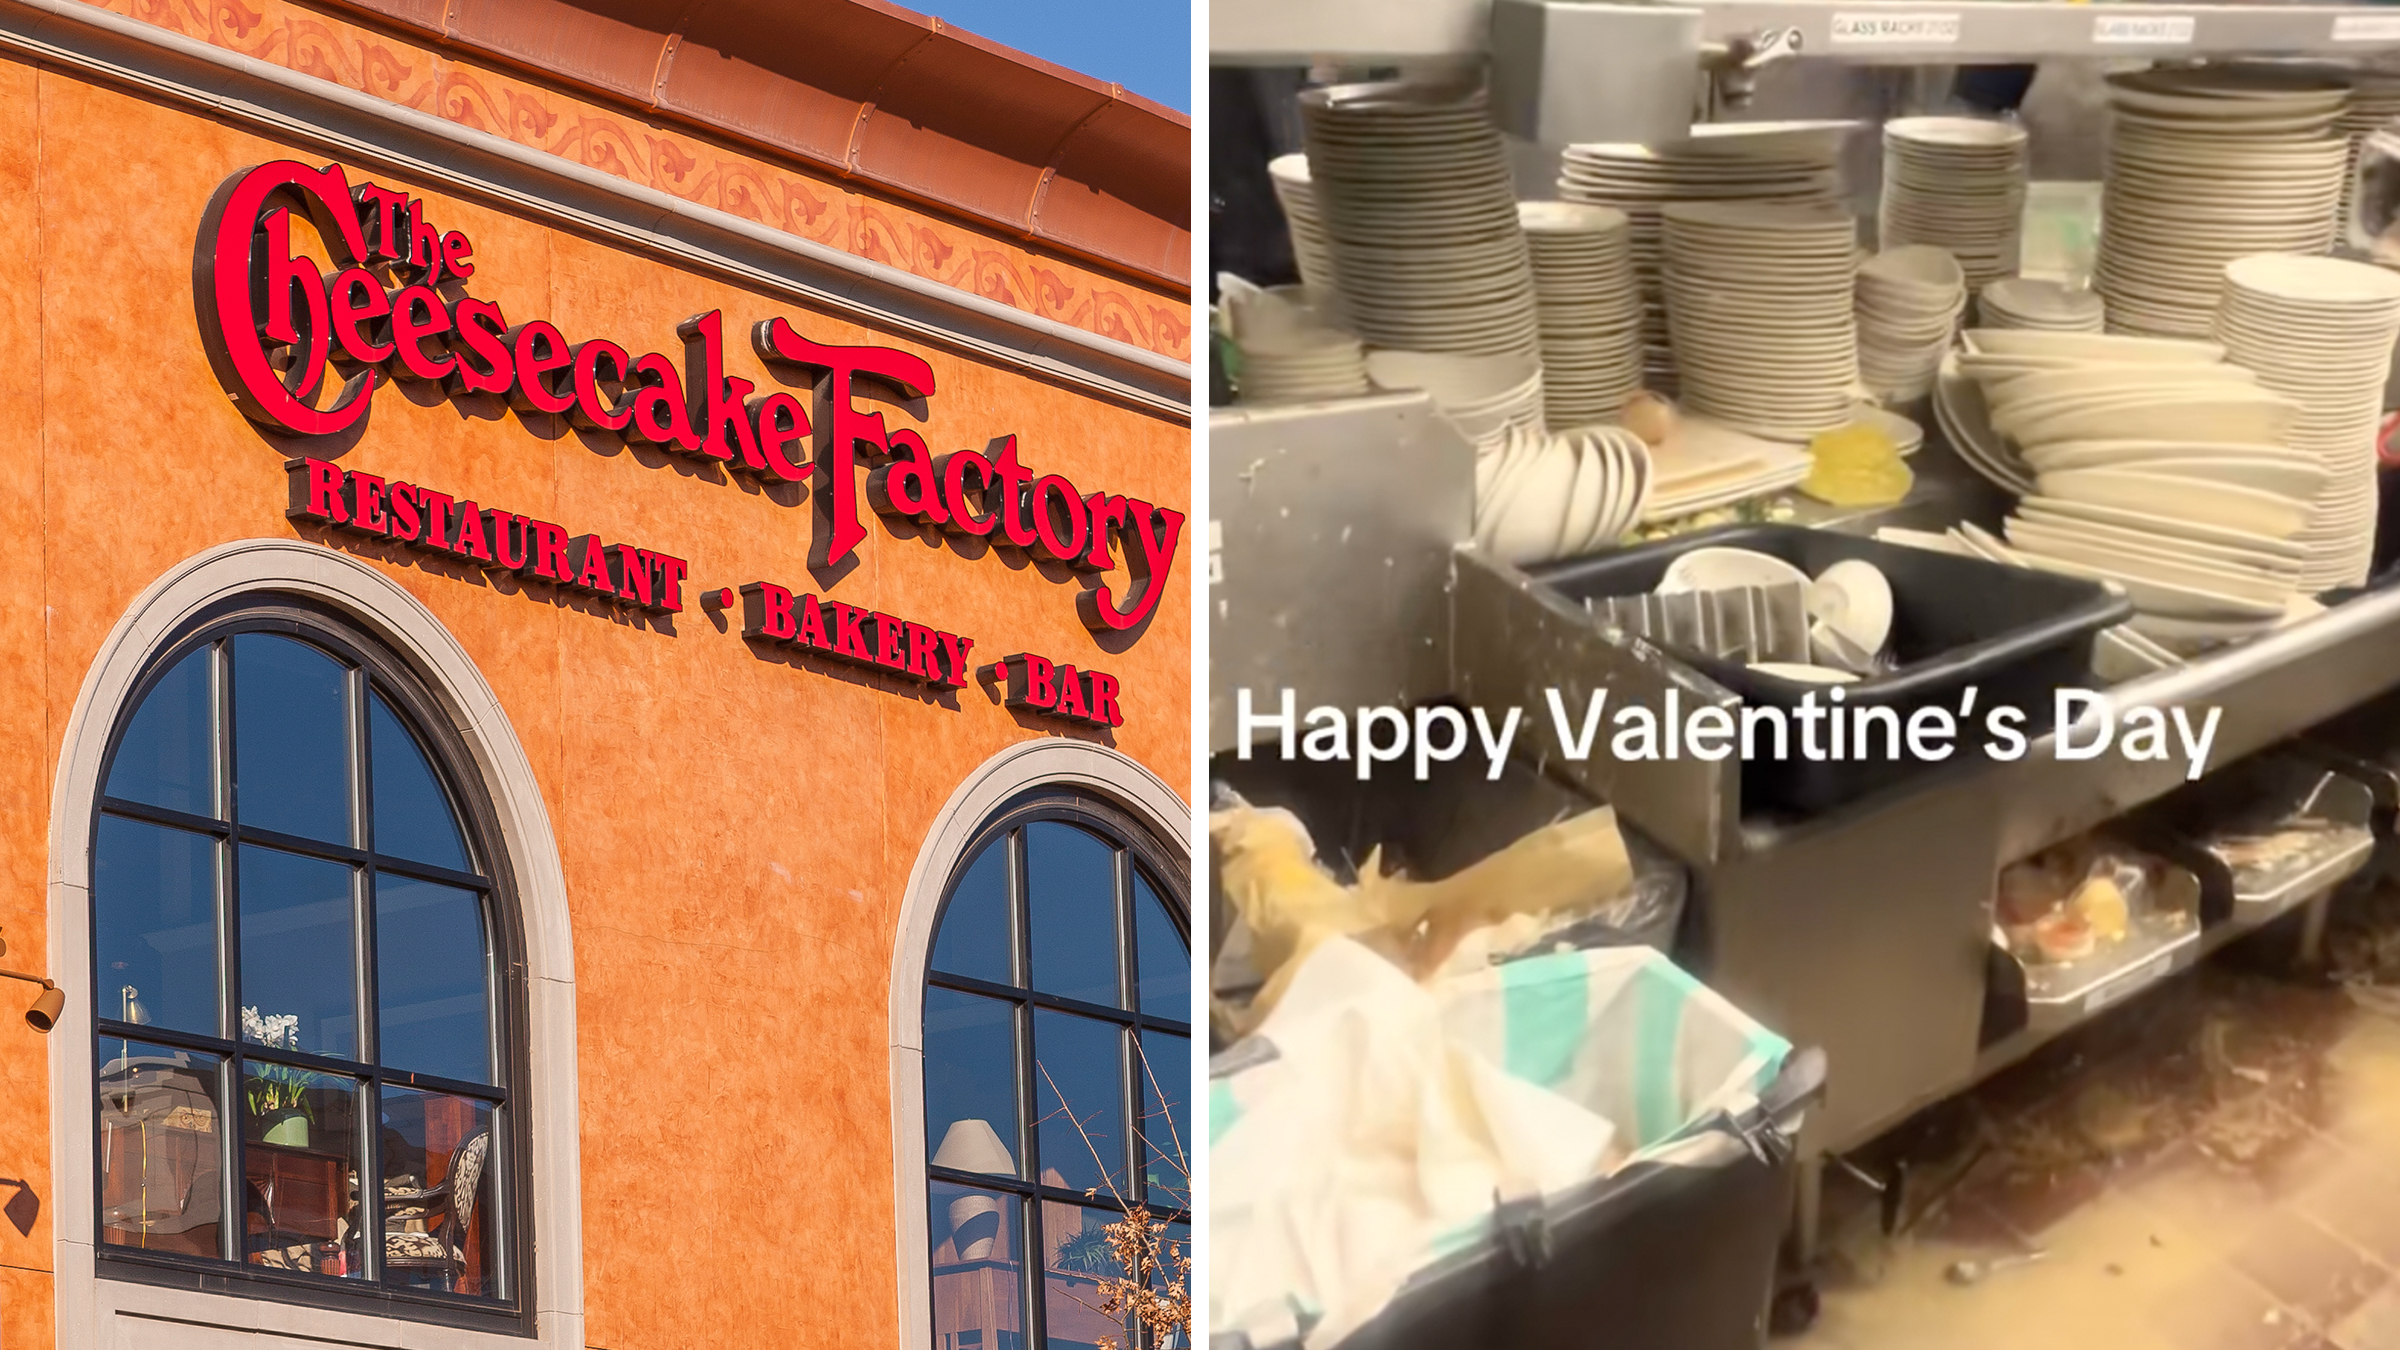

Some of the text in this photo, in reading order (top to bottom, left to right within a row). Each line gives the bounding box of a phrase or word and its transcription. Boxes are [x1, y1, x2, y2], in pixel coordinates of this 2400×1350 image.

[361, 182, 475, 286] The
[213, 160, 1185, 631] Cheesecake Factory
[304, 456, 1124, 728] RESTAURANT BAKERY BAR
